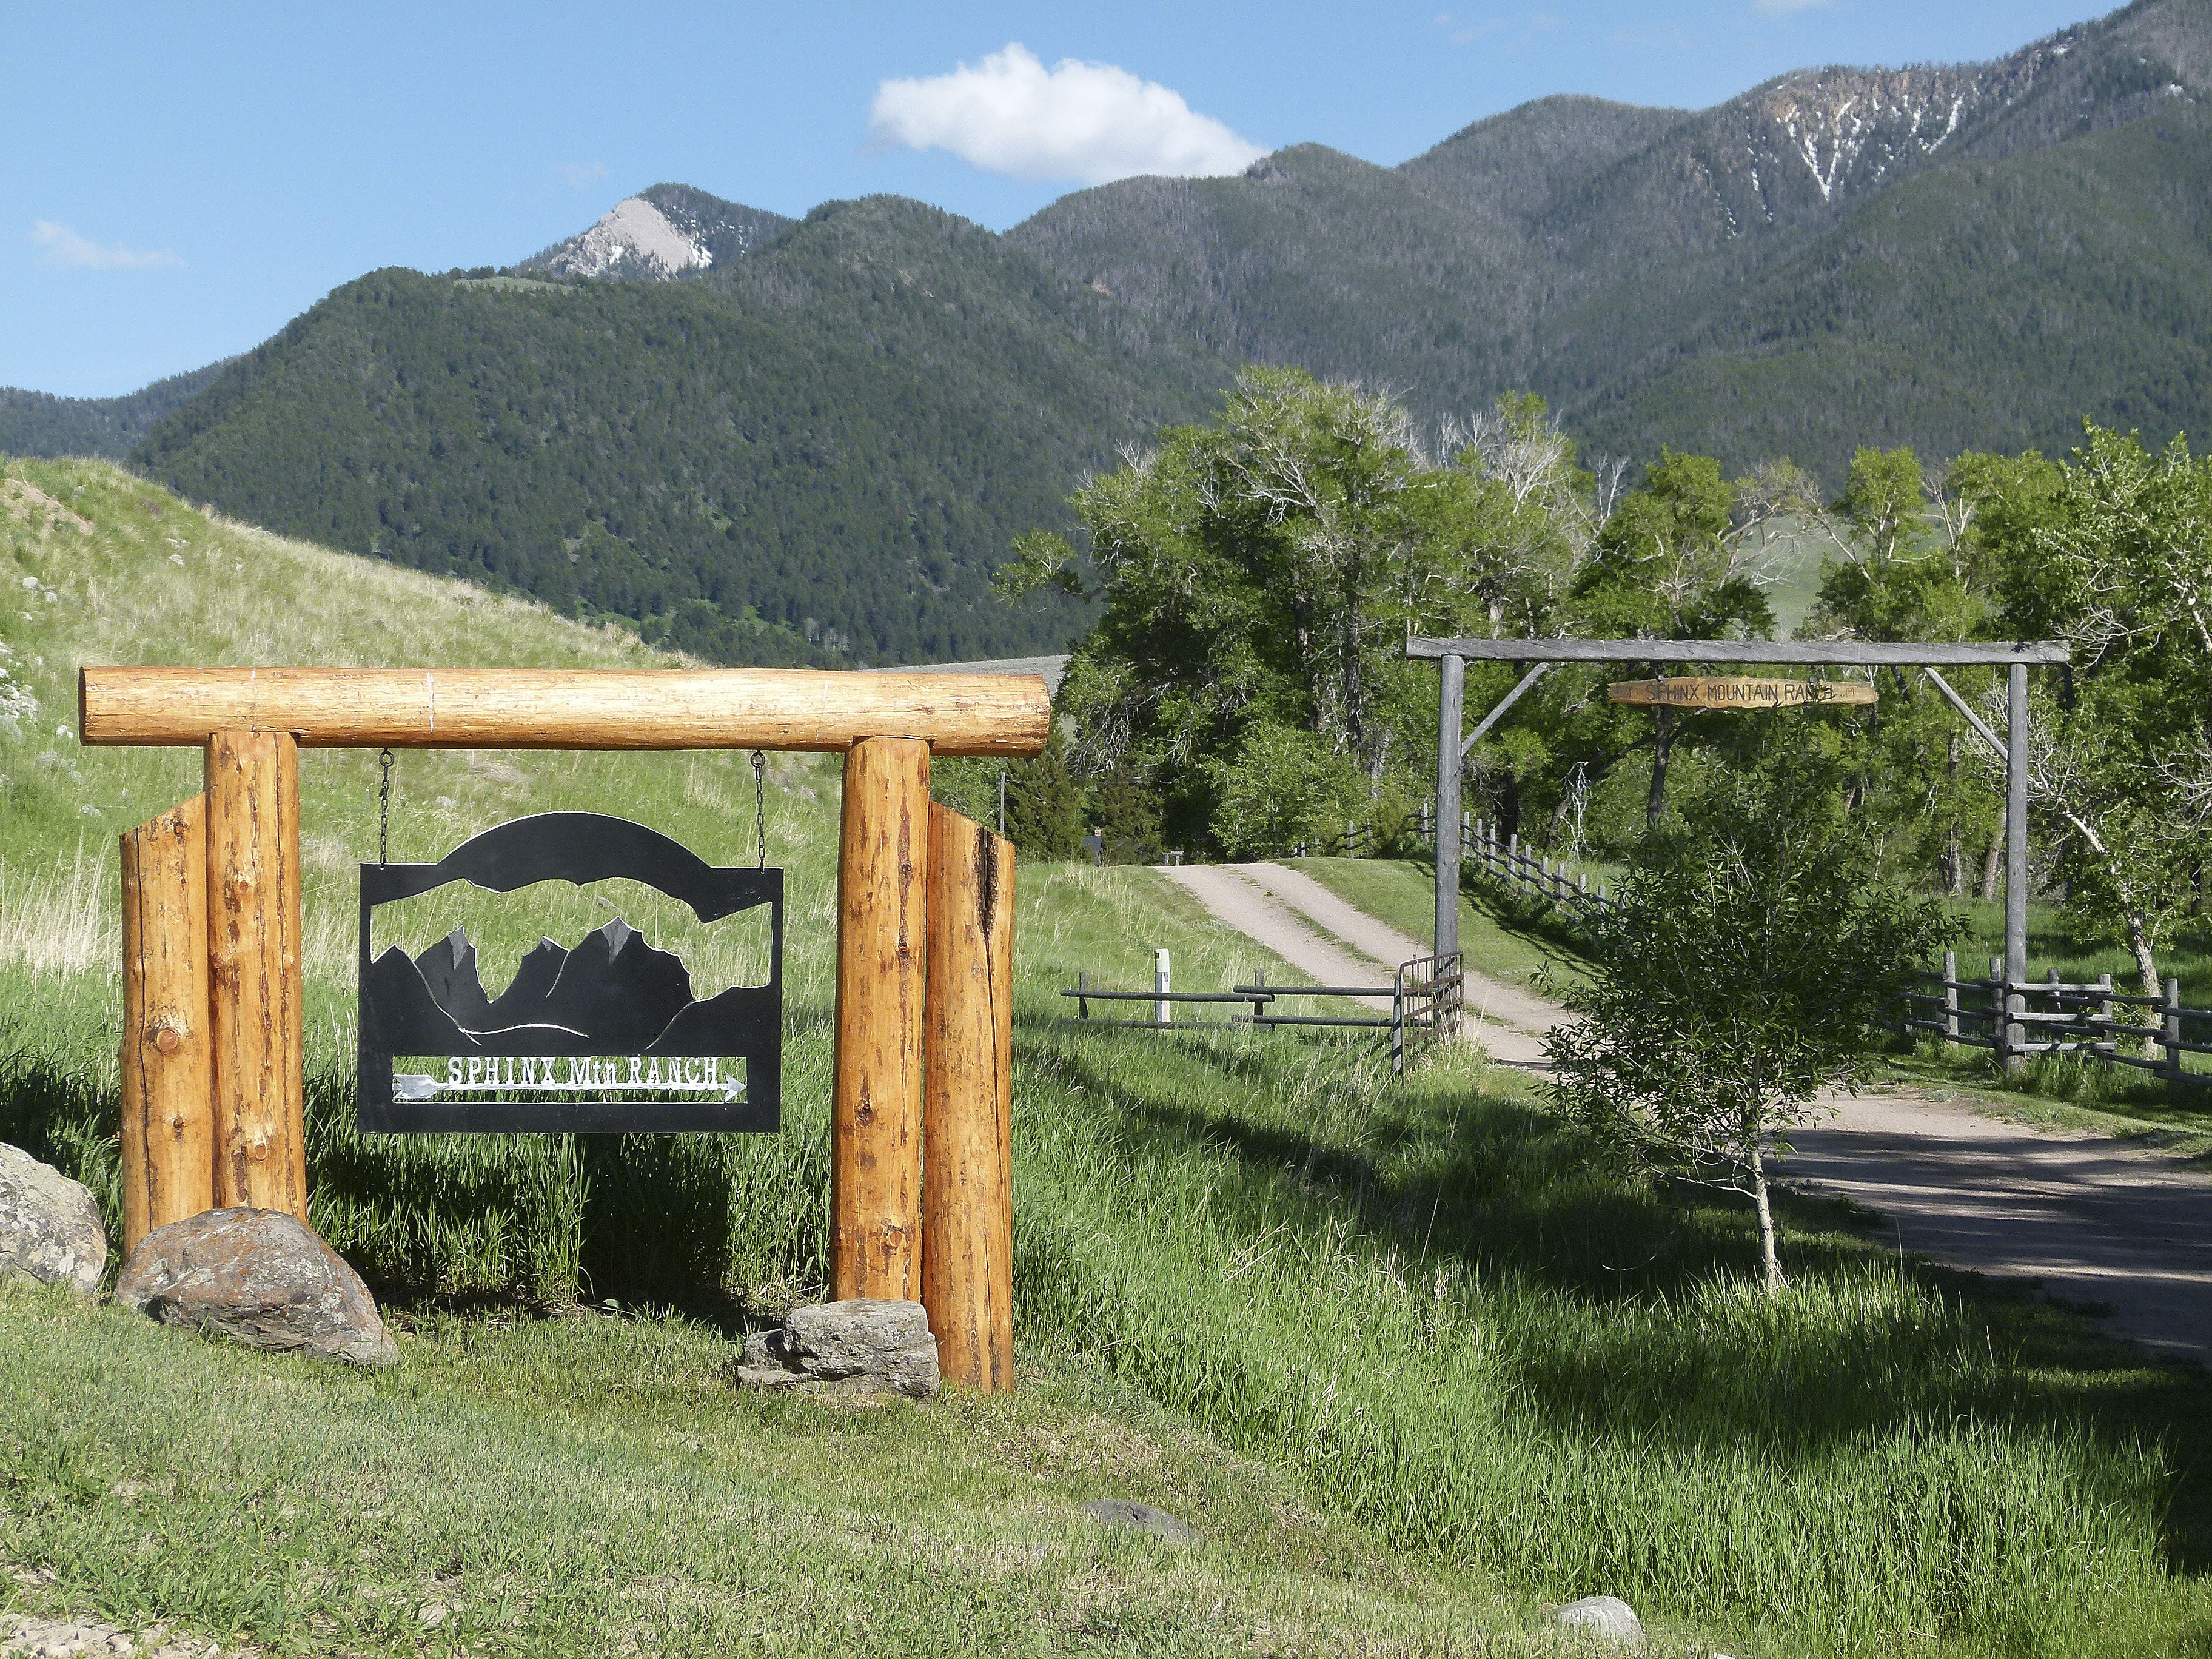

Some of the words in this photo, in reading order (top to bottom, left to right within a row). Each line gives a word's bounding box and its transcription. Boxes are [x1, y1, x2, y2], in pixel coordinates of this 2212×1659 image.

[1646, 682, 1700, 701] SPHINX
[1706, 684, 1778, 702] MOUNTAIN
[1784, 684, 1833, 701] RANH
[447, 1056, 554, 1084] SPHINX
[569, 1056, 617, 1084] Mtn
[630, 1057, 718, 1085] RANCH
